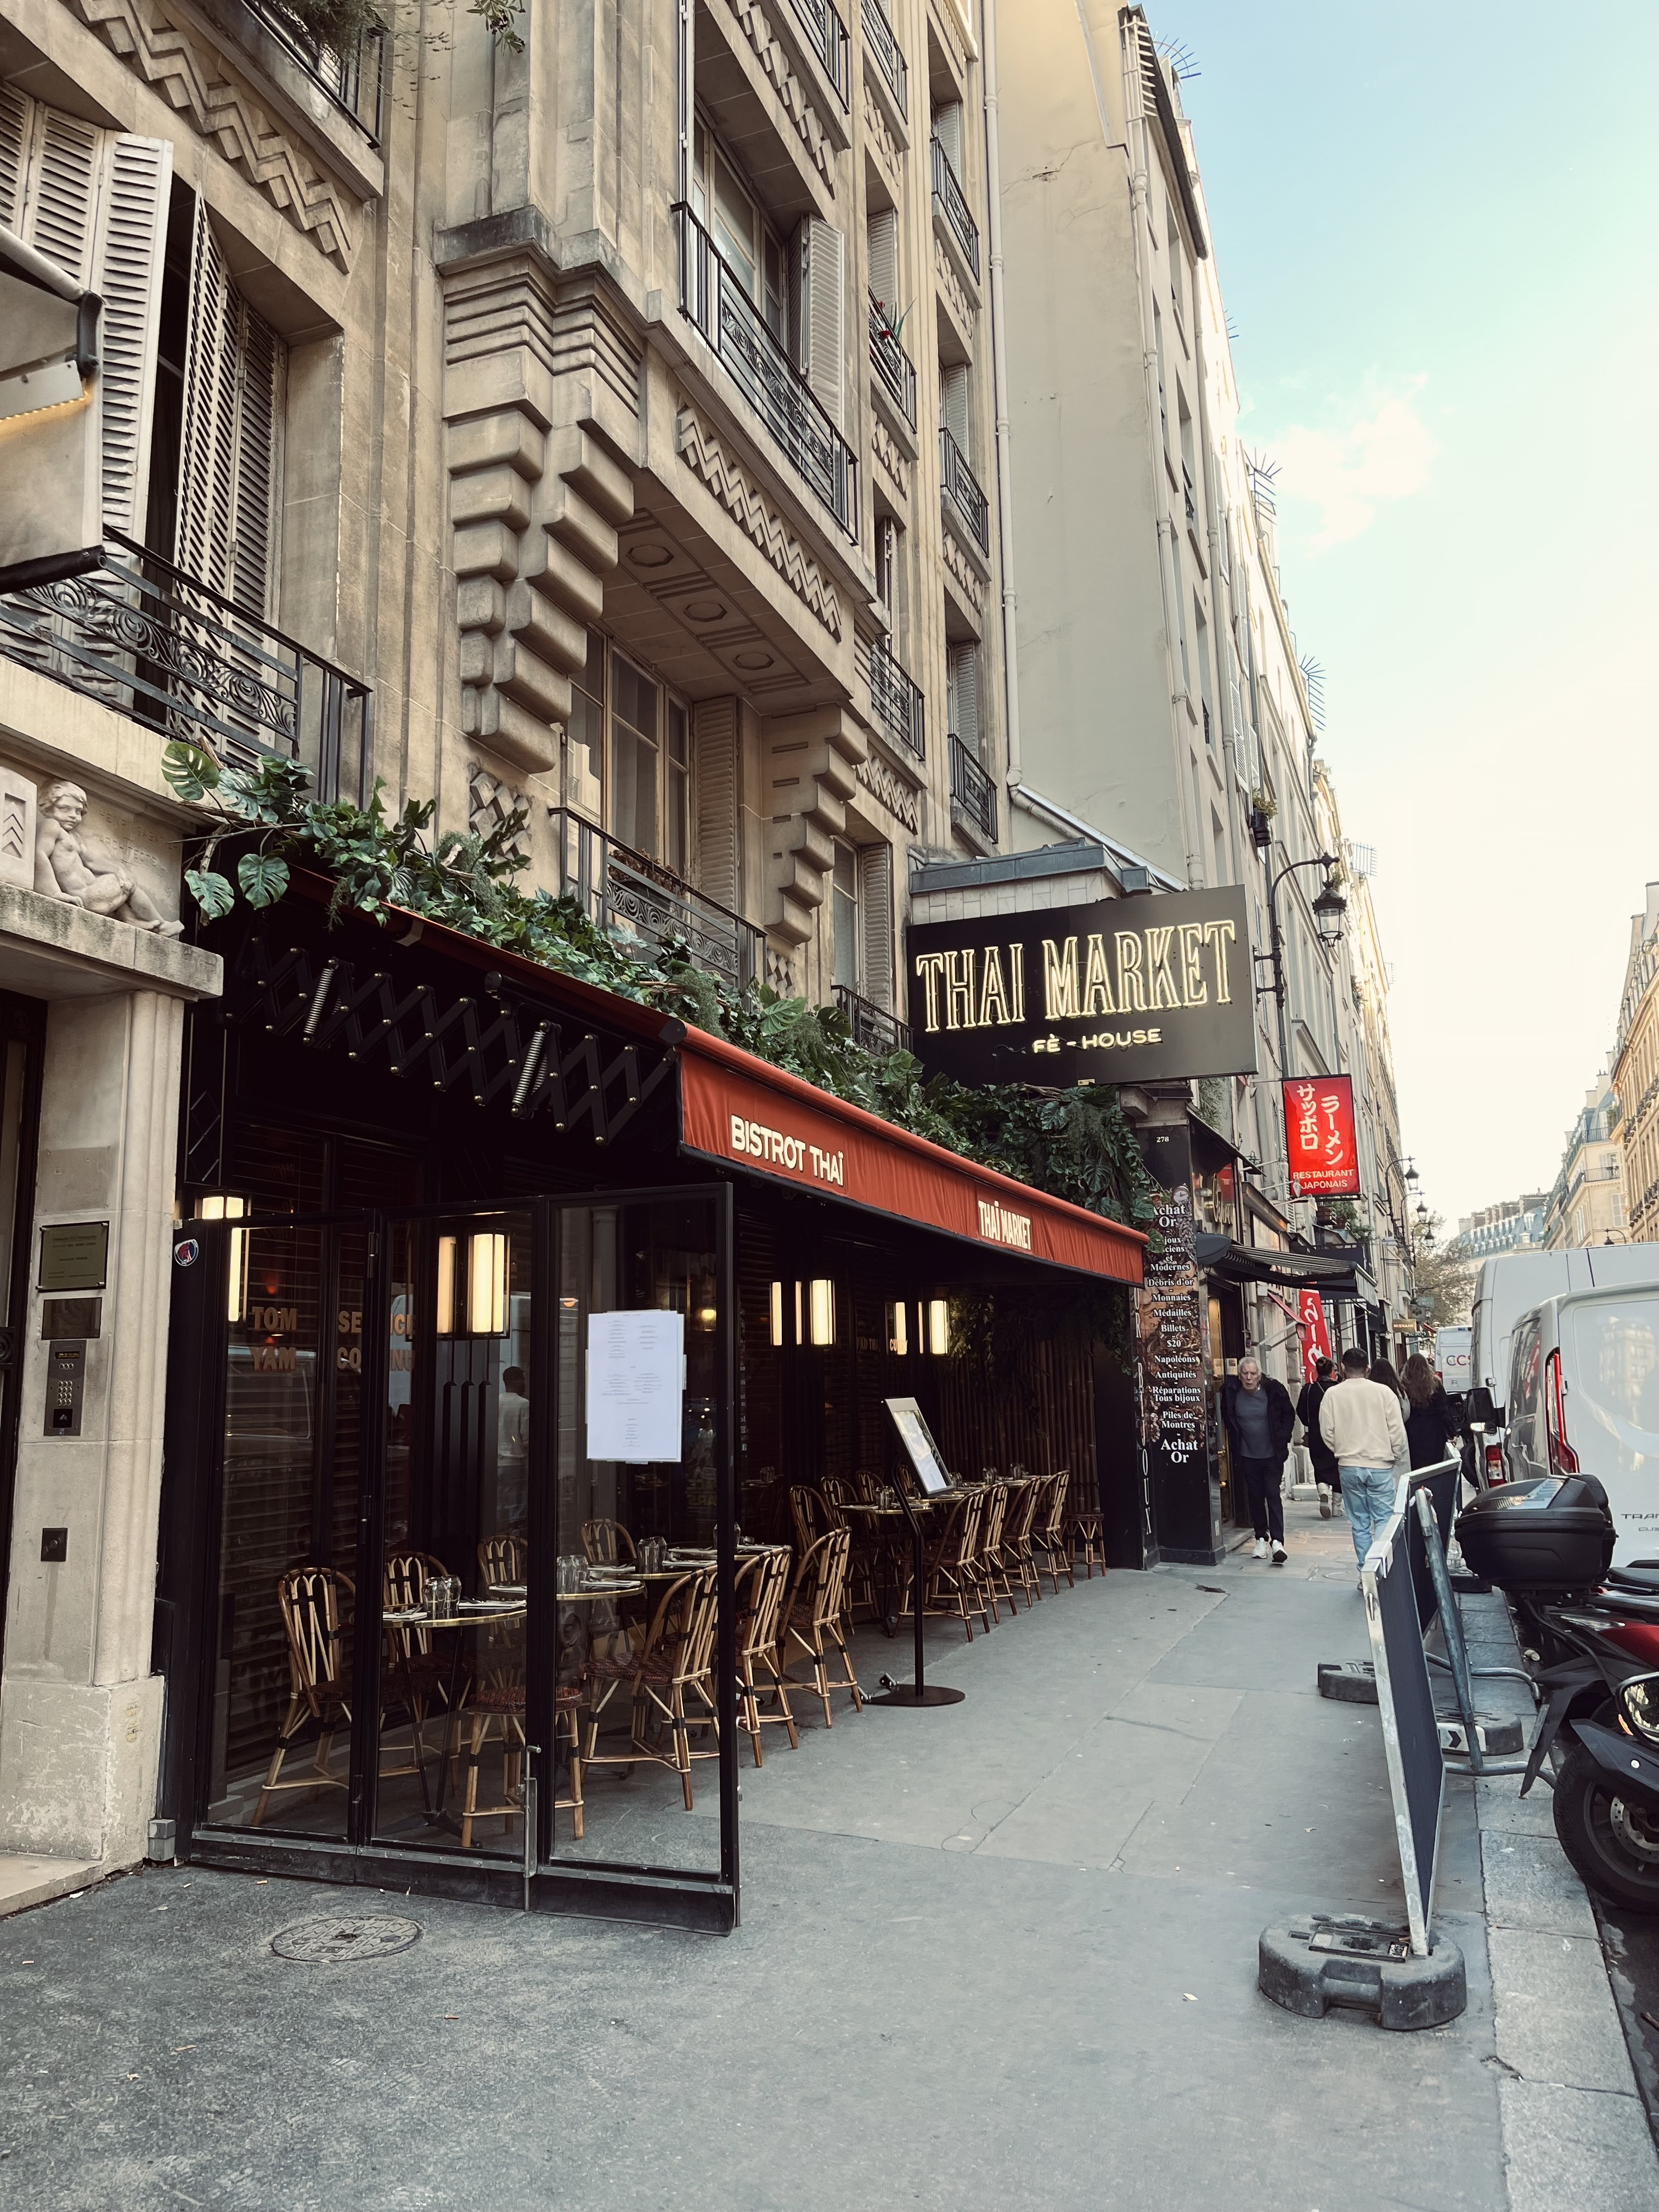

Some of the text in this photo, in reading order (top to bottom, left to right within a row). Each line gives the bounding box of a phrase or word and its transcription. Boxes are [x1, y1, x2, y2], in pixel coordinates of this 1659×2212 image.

[916, 919, 1237, 1033] THAI MARKET
[1081, 1028, 1163, 1050] HOUSE
[1296, 1083, 1318, 1150] サッポロ
[1321, 1095, 1344, 1165] ラーメン
[730, 1114, 845, 1187] BISTROT THAÏ
[1293, 1169, 1354, 1179] RESTAURANT
[1301, 1180, 1348, 1189] JAPONAIS
[1159, 1216, 1177, 1227] Or
[1001, 1212, 1031, 1250] MARKET
[1150, 1263, 1190, 1272] Modernes
[1148, 1278, 1175, 1286] Débris
[1153, 1308, 1192, 1317] Médailles
[252, 1306, 298, 1332] TOM
[1160, 1324, 1186, 1332] Billets
[249, 1346, 297, 1371] YAM
[1154, 1356, 1196, 1365] Napoléons
[1446, 1355, 1471, 1366] CC
[1155, 1371, 1197, 1380] Antiquités
[1152, 1385, 1201, 1396] Réparations
[1175, 1394, 1201, 1404] bijoux
[1163, 1410, 1182, 1419] Piles
[1137, 1362, 1152, 1535] BIJOUX
[1160, 1437, 1199, 1451] Achat
[1170, 1452, 1189, 1463] Or
